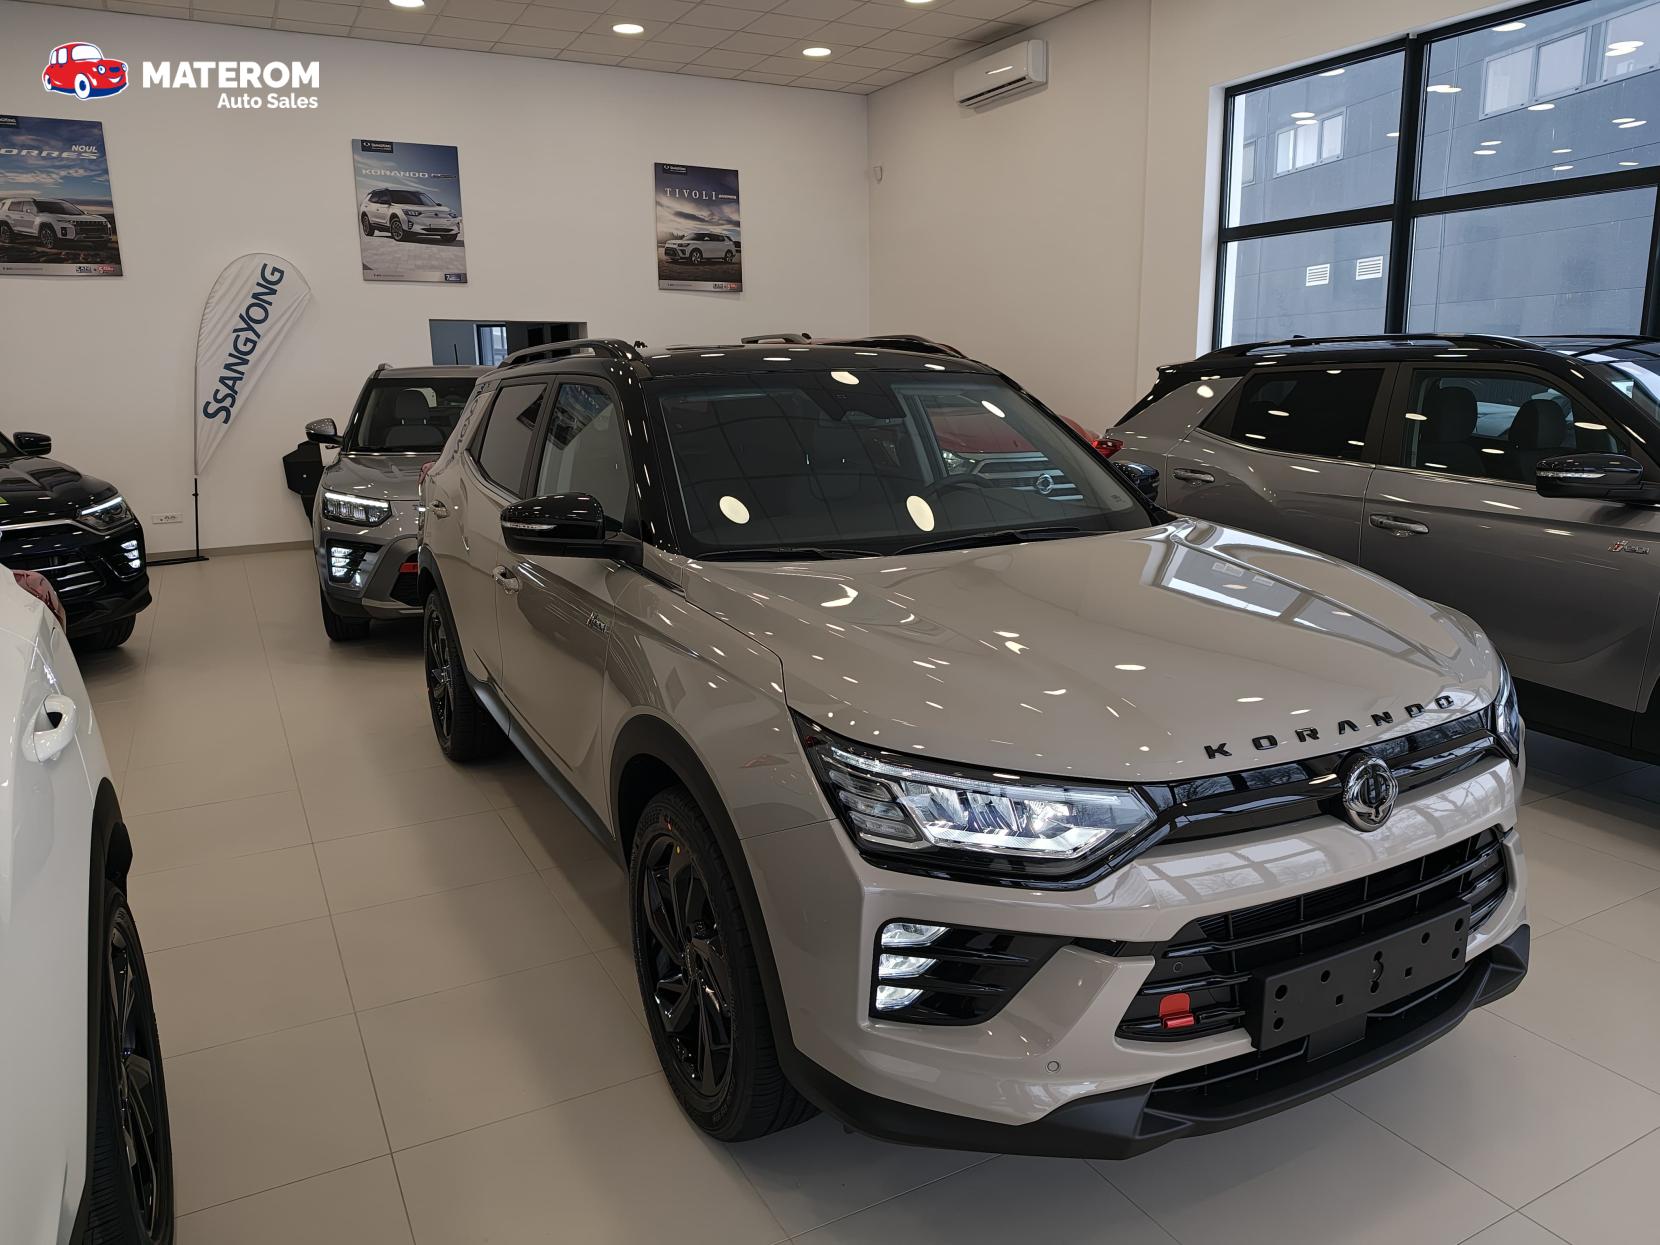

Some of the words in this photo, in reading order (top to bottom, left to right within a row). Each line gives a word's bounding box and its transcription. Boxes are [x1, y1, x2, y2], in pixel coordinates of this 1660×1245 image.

[71, 144, 98, 153] NOUL
[361, 169, 428, 178] KORANDO
[665, 187, 716, 200] TIVOLI
[202, 263, 285, 424] SSANGYONG
[1203, 694, 1455, 760] KORANDO
